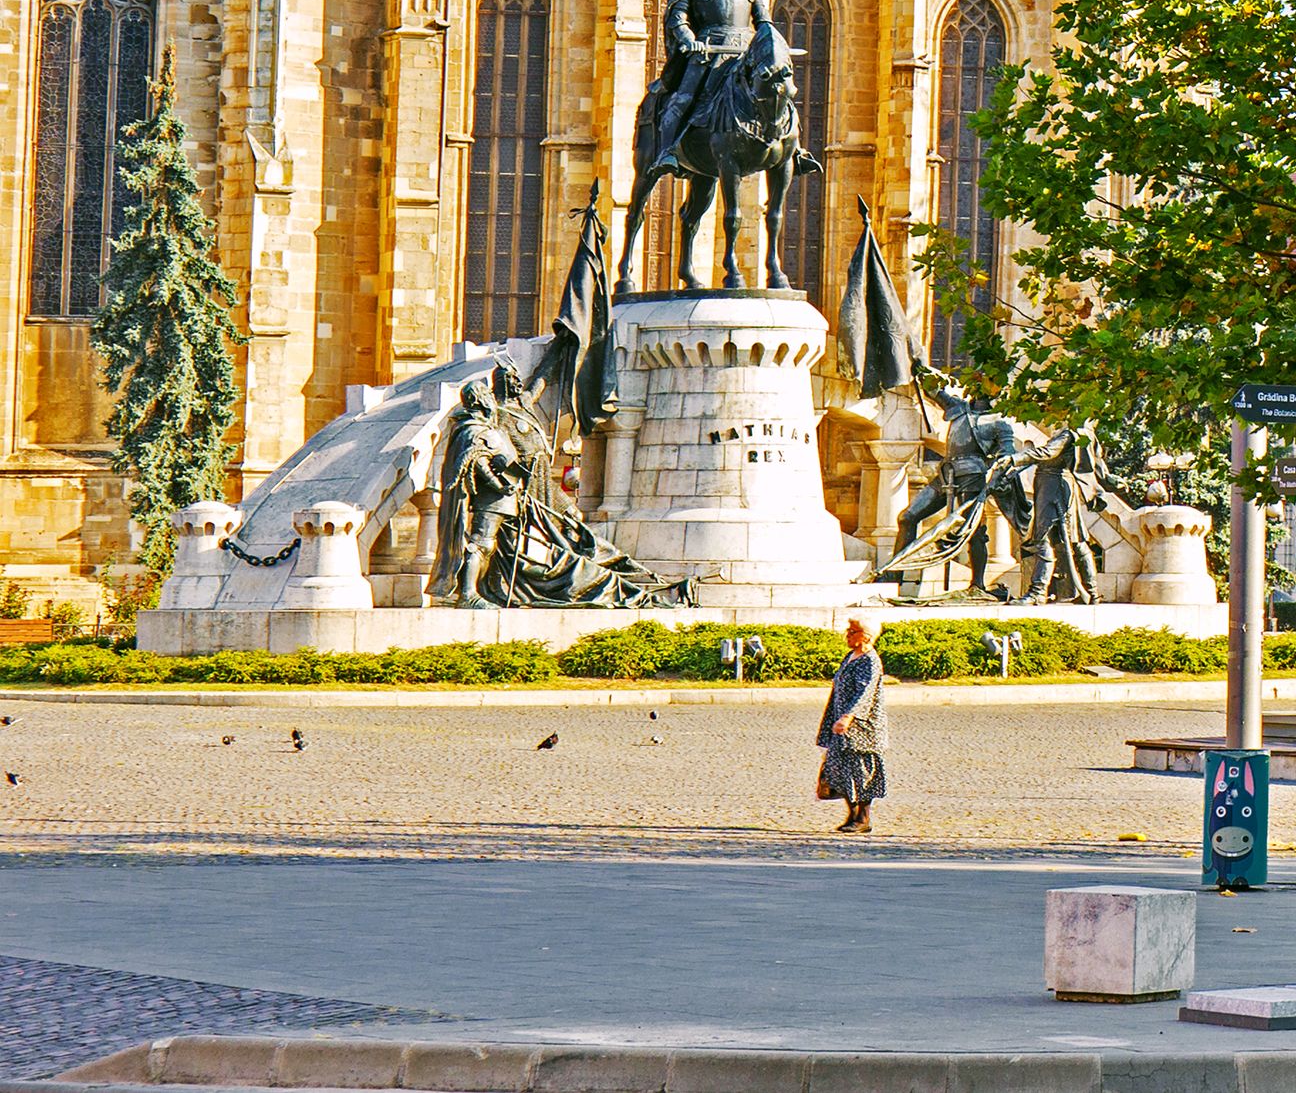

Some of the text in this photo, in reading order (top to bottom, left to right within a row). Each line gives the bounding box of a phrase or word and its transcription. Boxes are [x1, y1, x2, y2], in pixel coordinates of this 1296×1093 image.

[1257, 392, 1288, 402] Grădina
[708, 424, 810, 445] MATHIAS
[747, 450, 786, 463] REX
